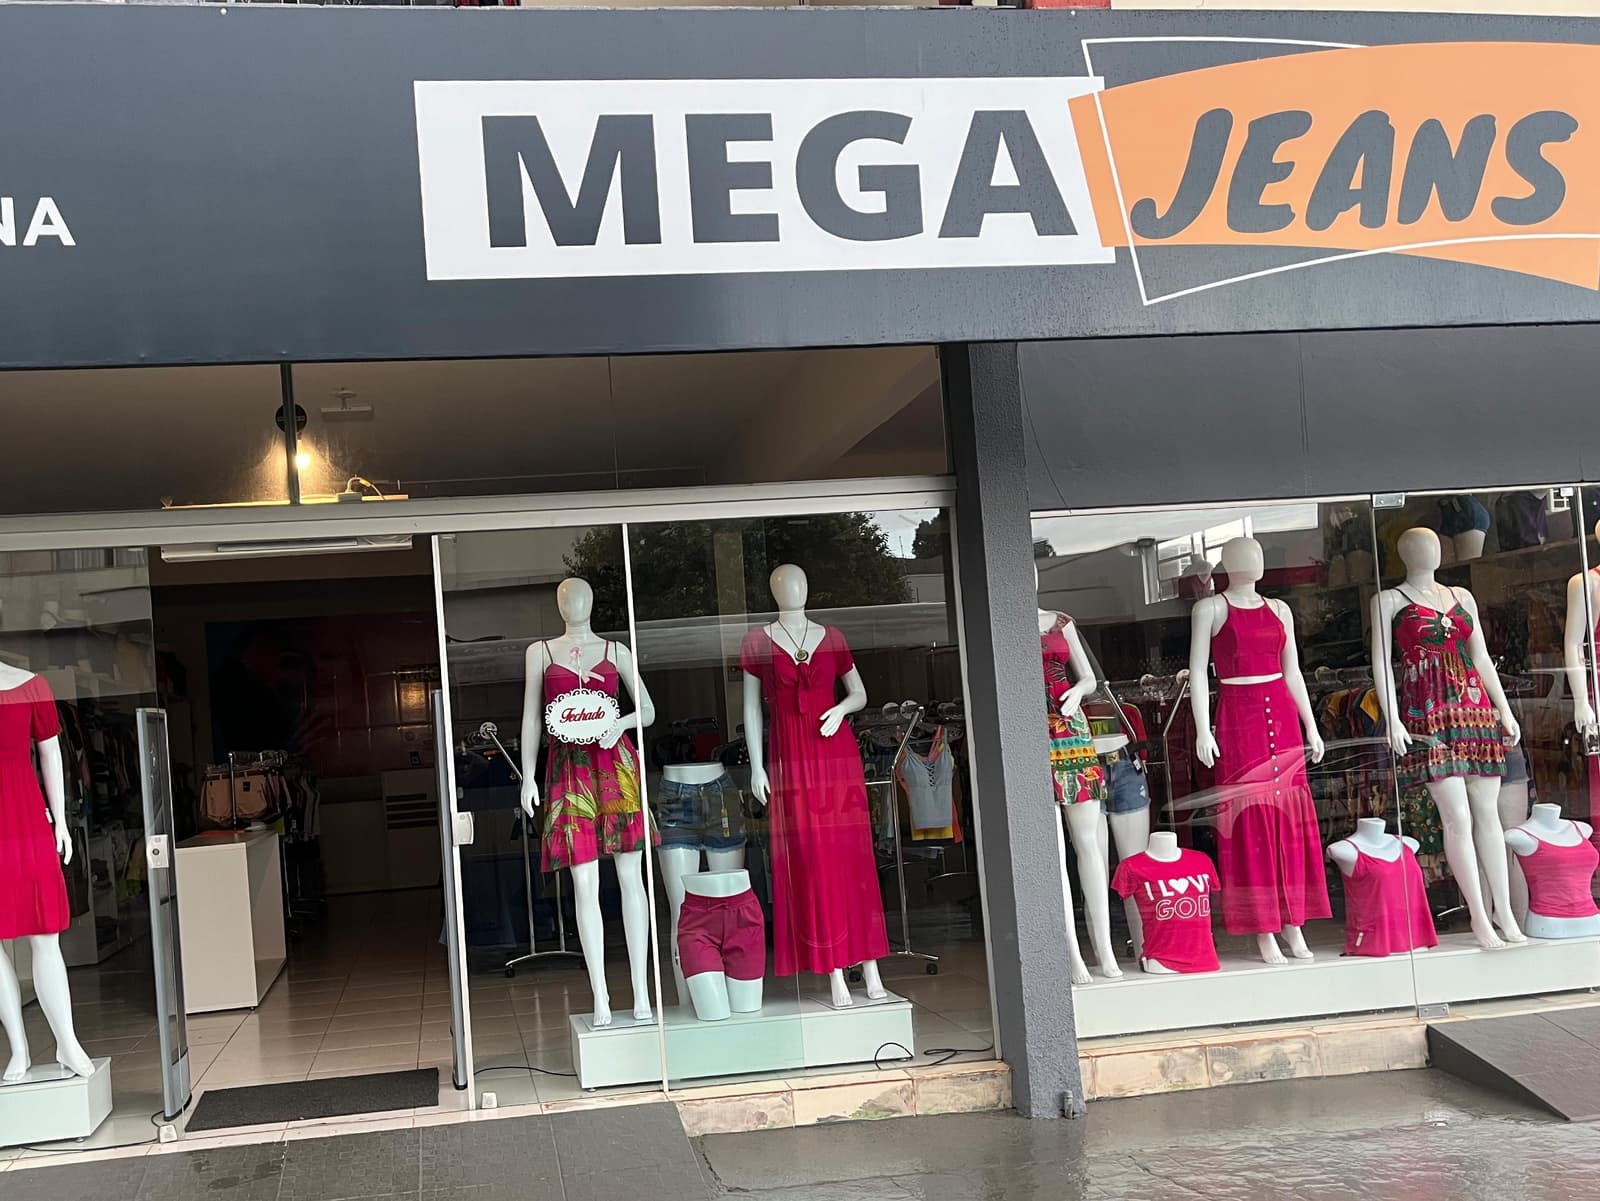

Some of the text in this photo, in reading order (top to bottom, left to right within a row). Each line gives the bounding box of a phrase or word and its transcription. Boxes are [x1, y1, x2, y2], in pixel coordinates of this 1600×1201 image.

[481, 109, 1579, 249] MEGA JEANS
[560, 706, 605, 723] Fechado
[1144, 881, 1154, 901] I
